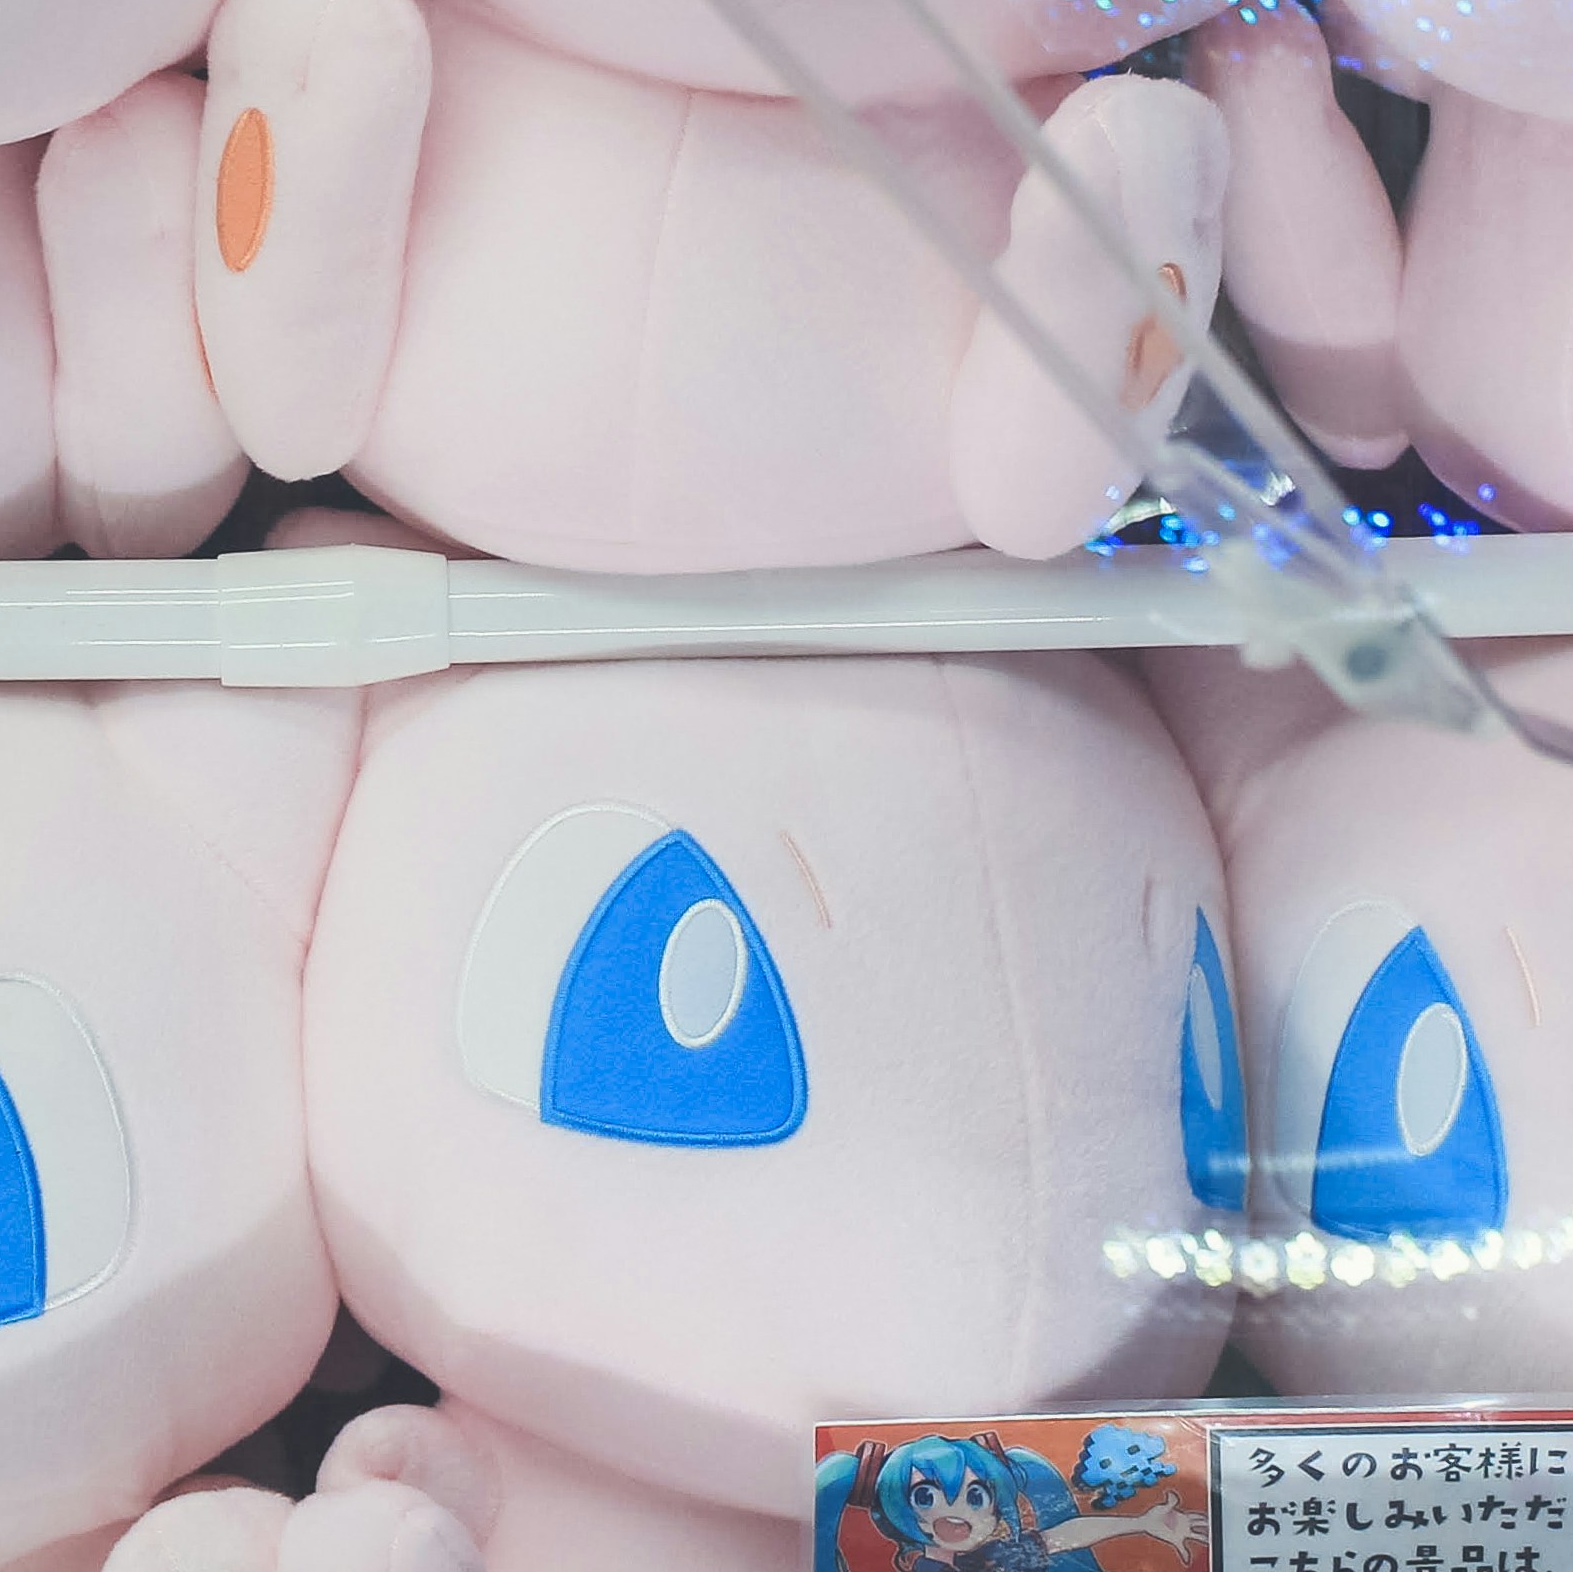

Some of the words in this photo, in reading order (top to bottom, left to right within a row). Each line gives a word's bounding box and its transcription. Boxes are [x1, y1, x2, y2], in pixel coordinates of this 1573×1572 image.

[1248, 1441, 1569, 1488] 多くのお客様に
